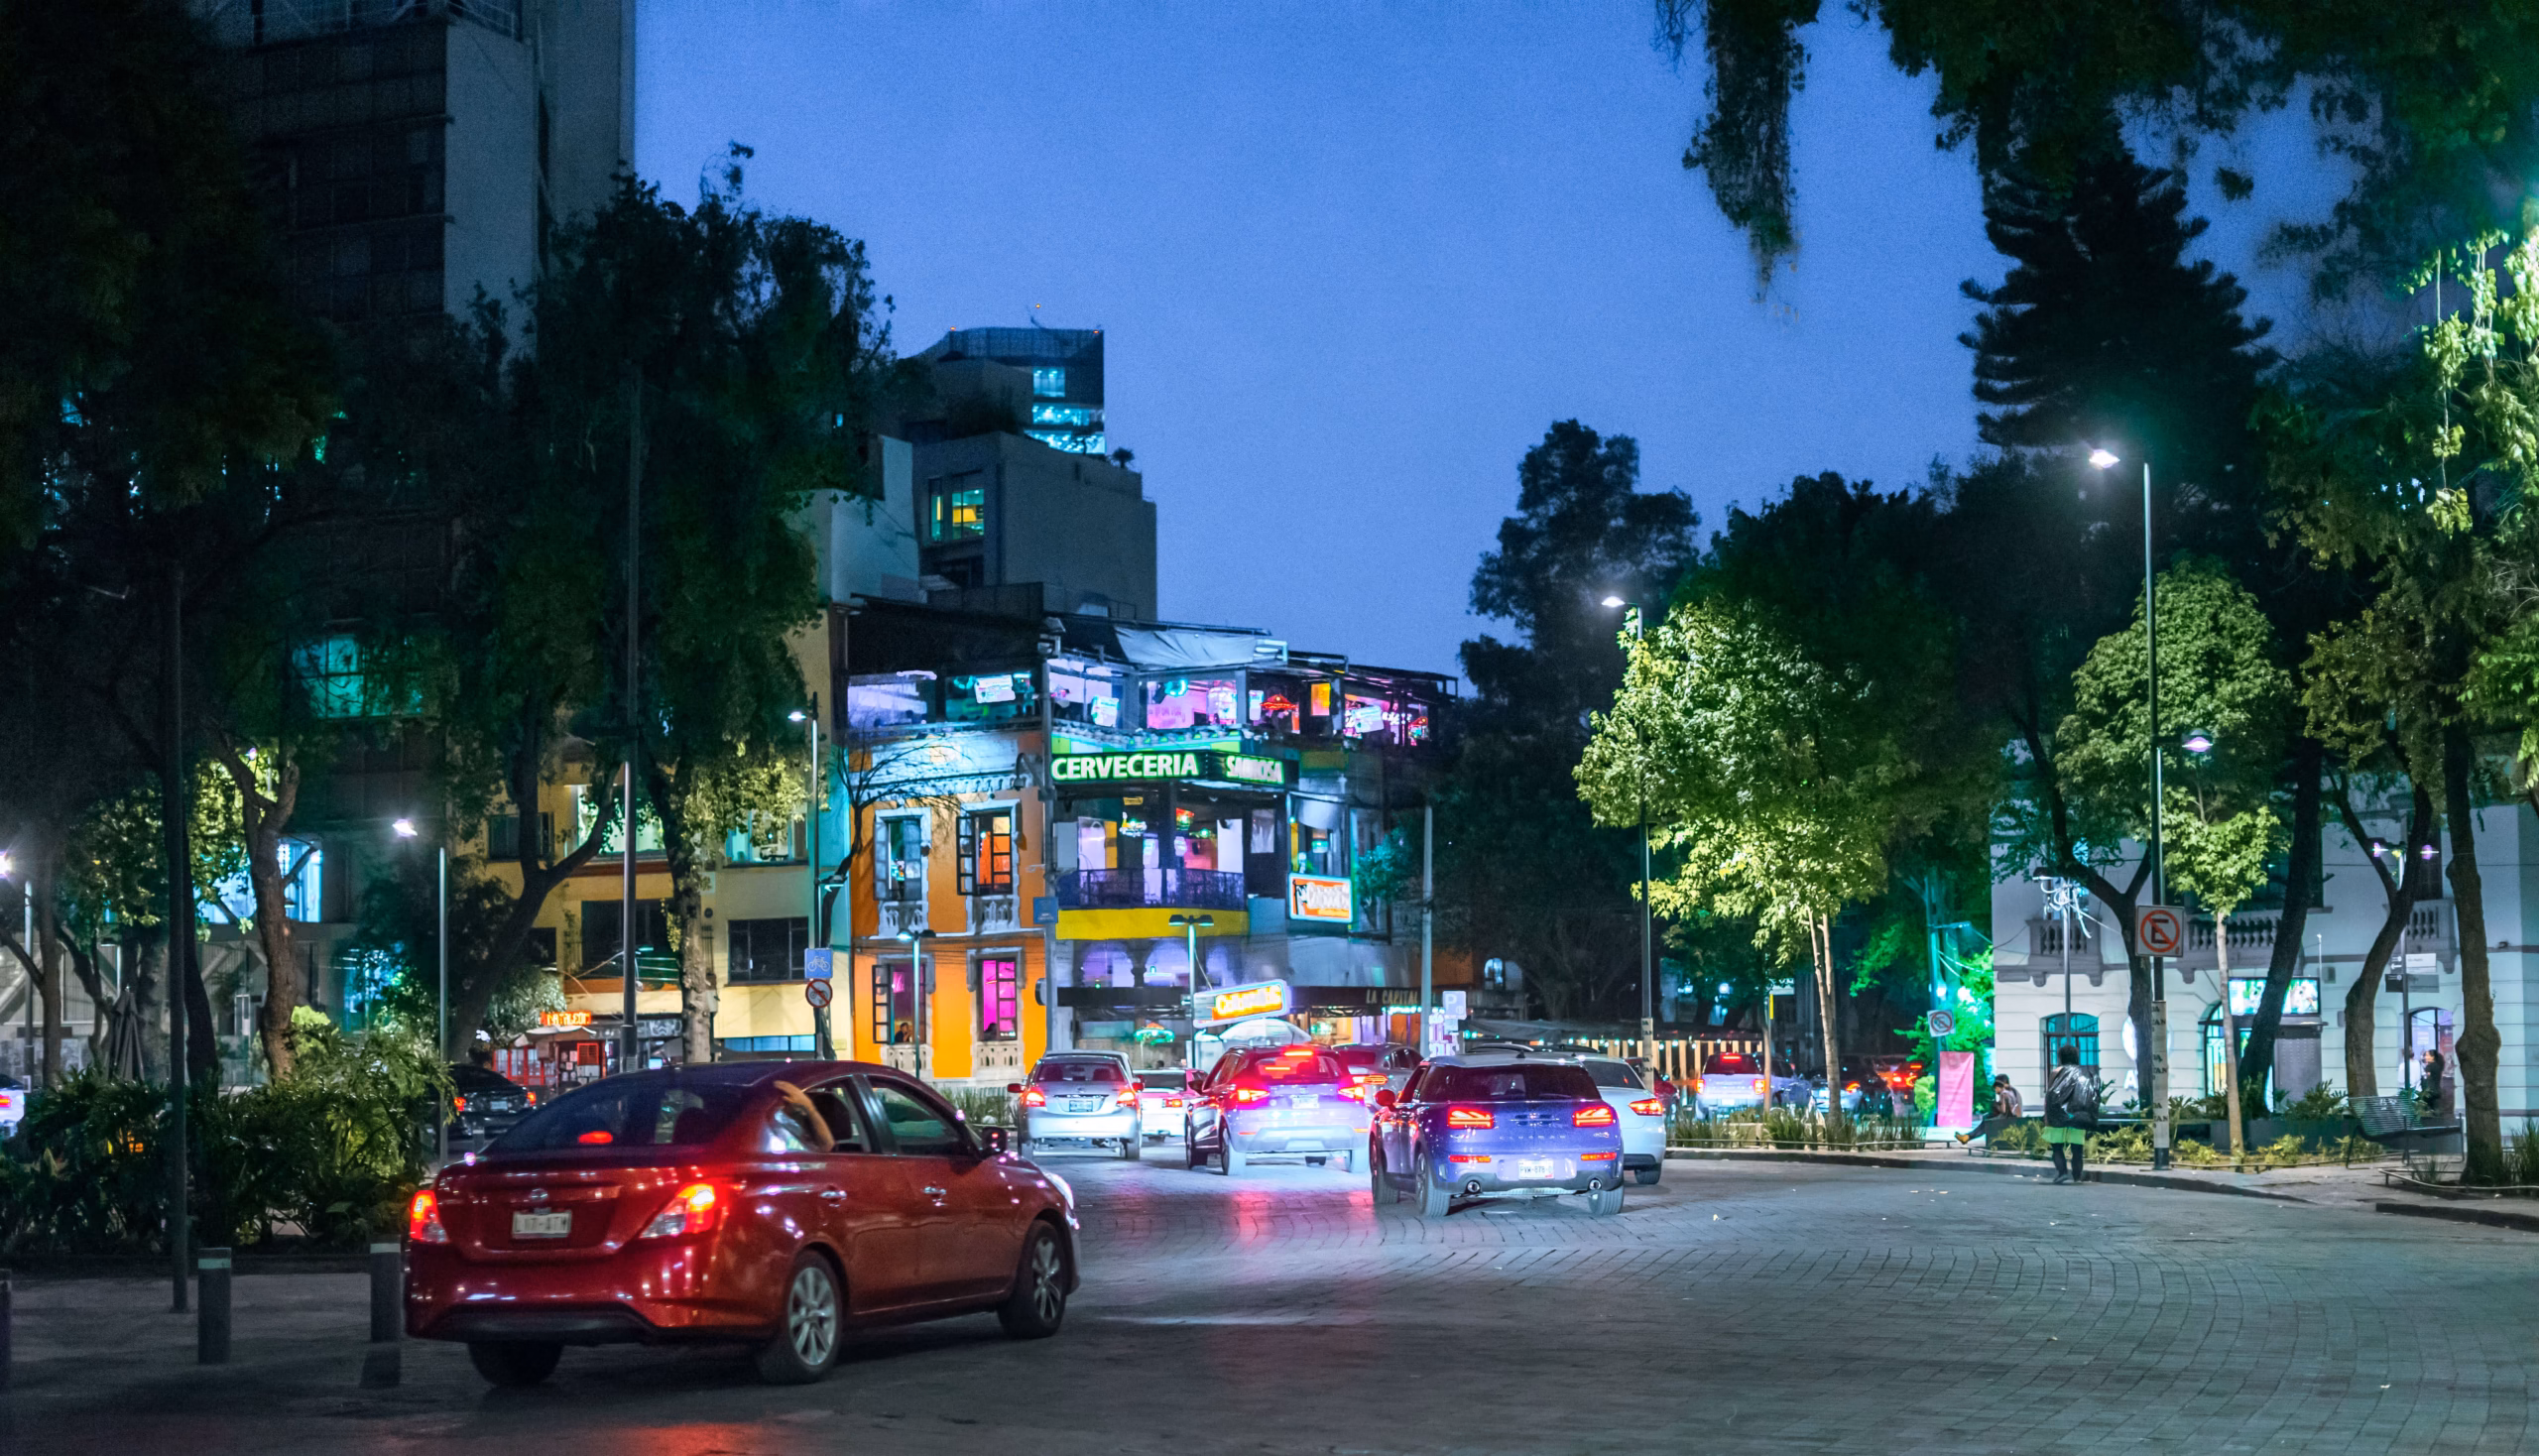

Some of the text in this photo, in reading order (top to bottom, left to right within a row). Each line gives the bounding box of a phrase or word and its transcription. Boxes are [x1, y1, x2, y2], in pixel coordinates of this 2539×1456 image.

[1052, 754, 1198, 780] CERVECERIA
[1366, 989, 1378, 1004] LA
[1382, 989, 1418, 1005] CAPITAL
[1447, 994, 1457, 1006] P
